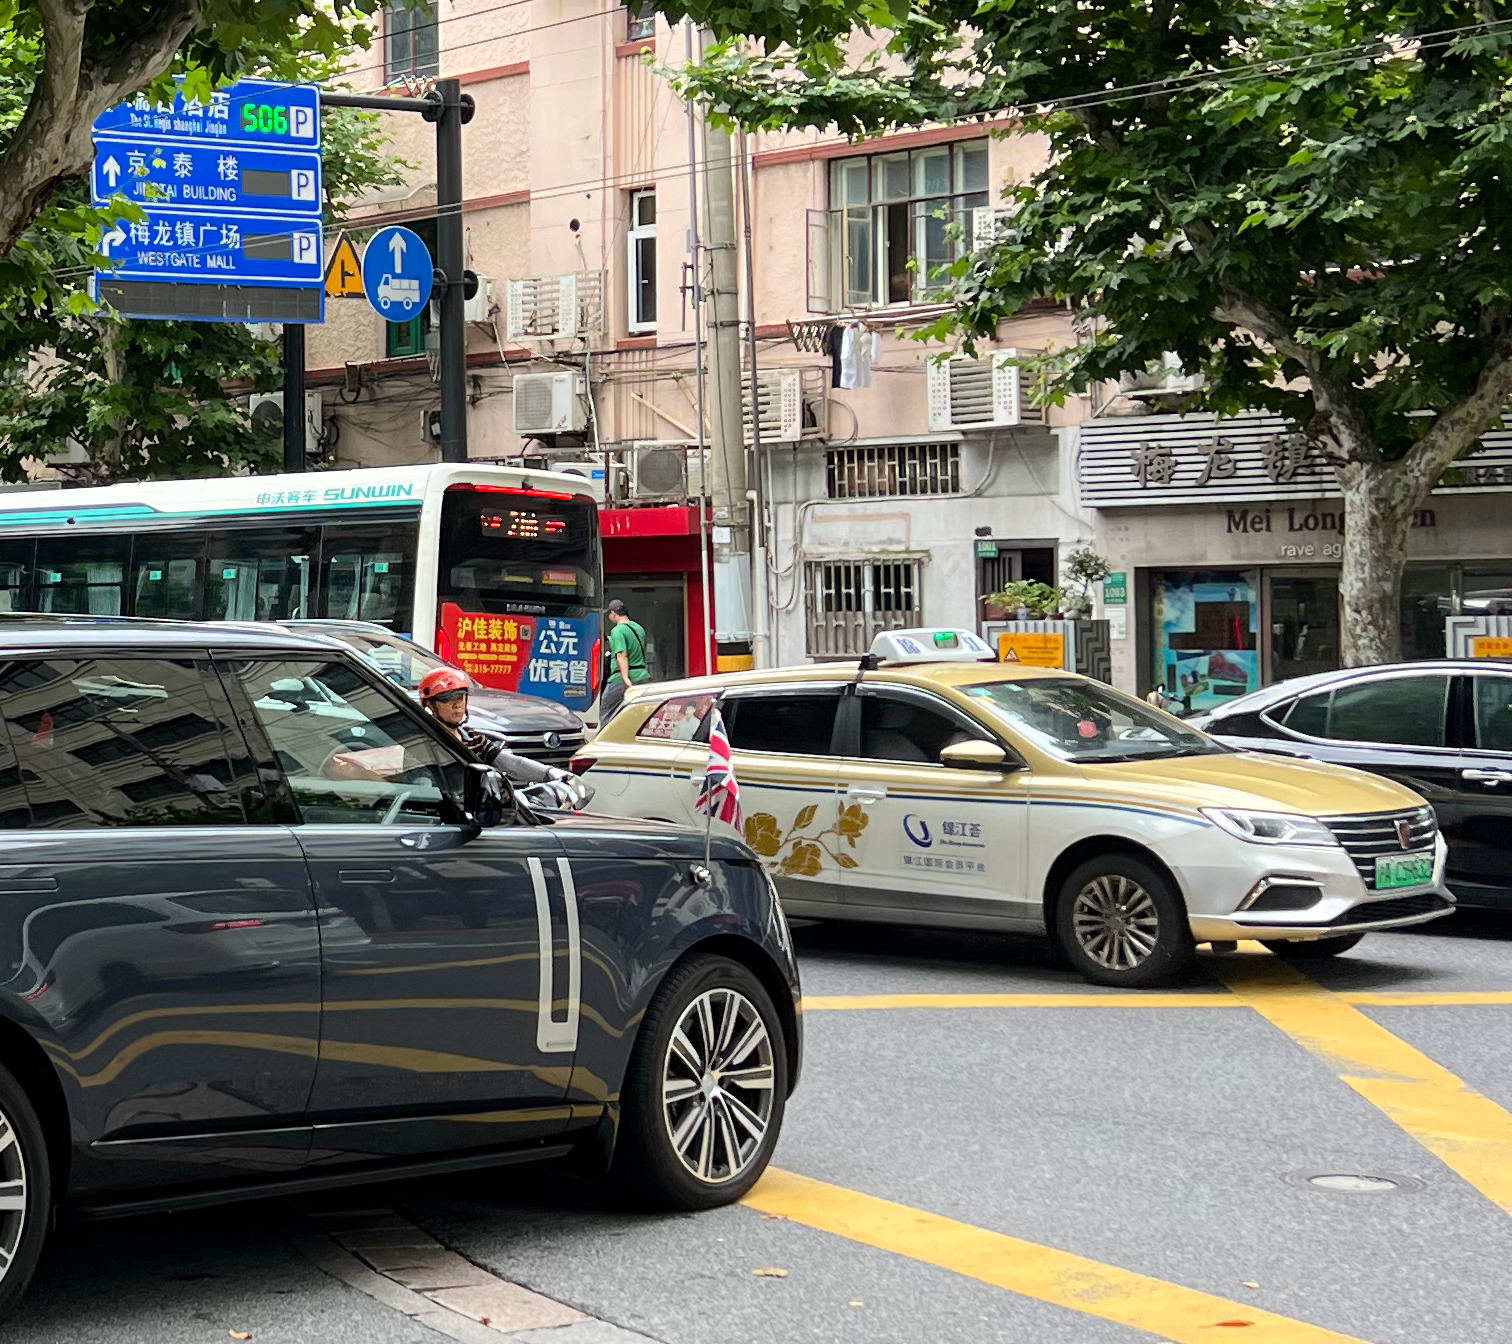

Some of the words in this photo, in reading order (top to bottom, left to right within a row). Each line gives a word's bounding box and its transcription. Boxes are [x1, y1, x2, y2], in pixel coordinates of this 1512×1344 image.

[242, 103, 288, 135] 506
[125, 150, 239, 181] 京泰楼
[182, 185, 237, 202] BUILDING
[128, 219, 241, 249] 梅龙镇广场
[137, 250, 202, 268] WESTGATE
[206, 254, 237, 270] MALL
[1129, 433, 1317, 488] 梅龙镇
[256, 489, 319, 505] 申沃客车
[323, 483, 414, 501] SUNWIN
[1225, 508, 1273, 534] Mei
[1280, 543, 1315, 556] rave
[457, 617, 519, 641] 沪佳装饰
[538, 629, 579, 655] 公元
[528, 658, 589, 685] 优家管
